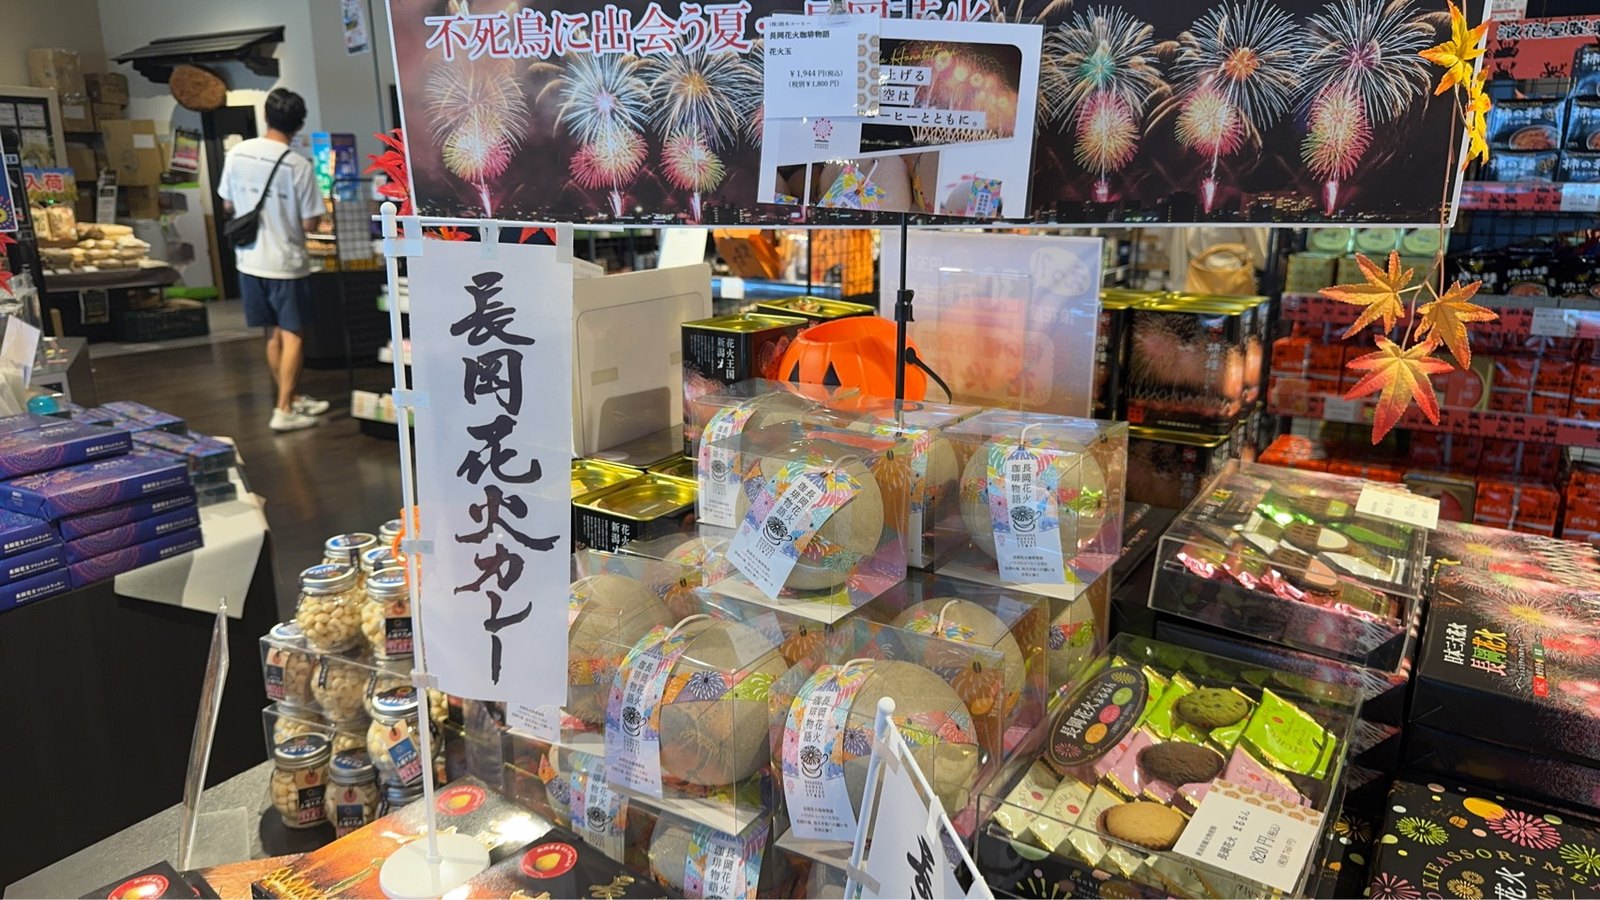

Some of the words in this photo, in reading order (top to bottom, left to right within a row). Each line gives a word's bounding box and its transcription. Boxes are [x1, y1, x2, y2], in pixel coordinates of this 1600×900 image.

[769, 30, 830, 40] 長岡花火珈琲物語
[769, 47, 792, 56] 花火玉
[883, 88, 909, 101] 空は
[889, 68, 924, 82] 上げる
[867, 111, 978, 127] ーヒーとともに。
[717, 336, 725, 358] 新潟
[726, 337, 735, 380] 花火王国
[450, 271, 561, 686] 長岡花火カレー
[775, 481, 808, 517] 珈琲物語
[1011, 463, 1021, 504] 珈琲物語
[1022, 463, 1032, 504] 長岡花火
[785, 489, 815, 525] 長岡花火
[611, 521, 620, 544] 新潟
[1443, 622, 1467, 665] 日本三大花火
[1470, 628, 1508, 677] 長岡花火
[627, 659, 649, 706] 珈琲物語
[634, 660, 653, 706] 長岡花火
[803, 695, 822, 742] 珈琲物語
[812, 696, 830, 744] 長岡花火
[1217, 836, 1238, 860] 長岡花火
[1233, 810, 1250, 832] まるるん
[709, 845, 724, 892] 珈琲物語
[720, 847, 735, 895] 長岡花火
